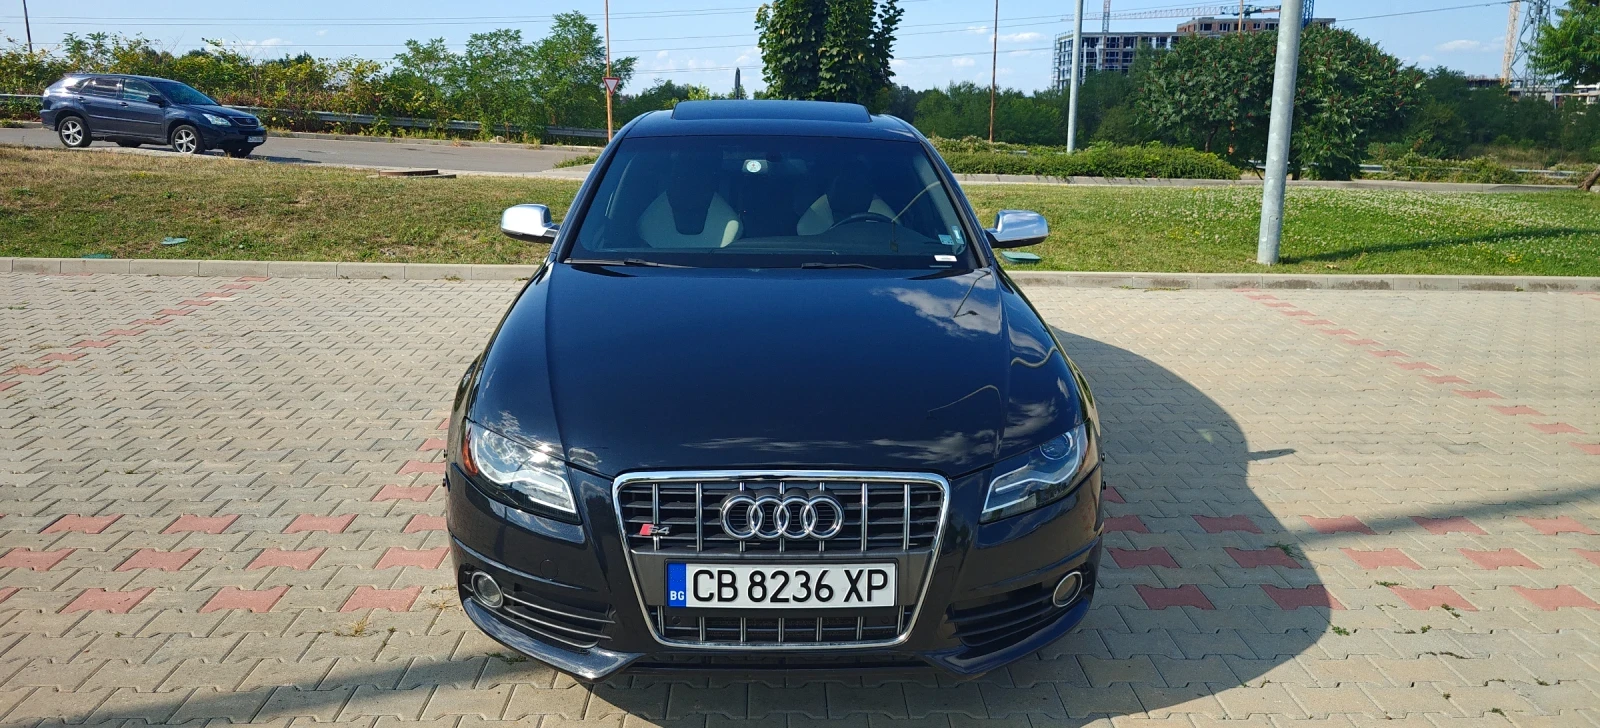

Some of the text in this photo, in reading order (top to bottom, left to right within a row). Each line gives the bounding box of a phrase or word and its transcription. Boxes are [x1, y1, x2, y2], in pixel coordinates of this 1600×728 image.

[648, 524, 671, 536] S4
[693, 569, 888, 603] CB 8236 XP
[670, 591, 685, 601] BG
